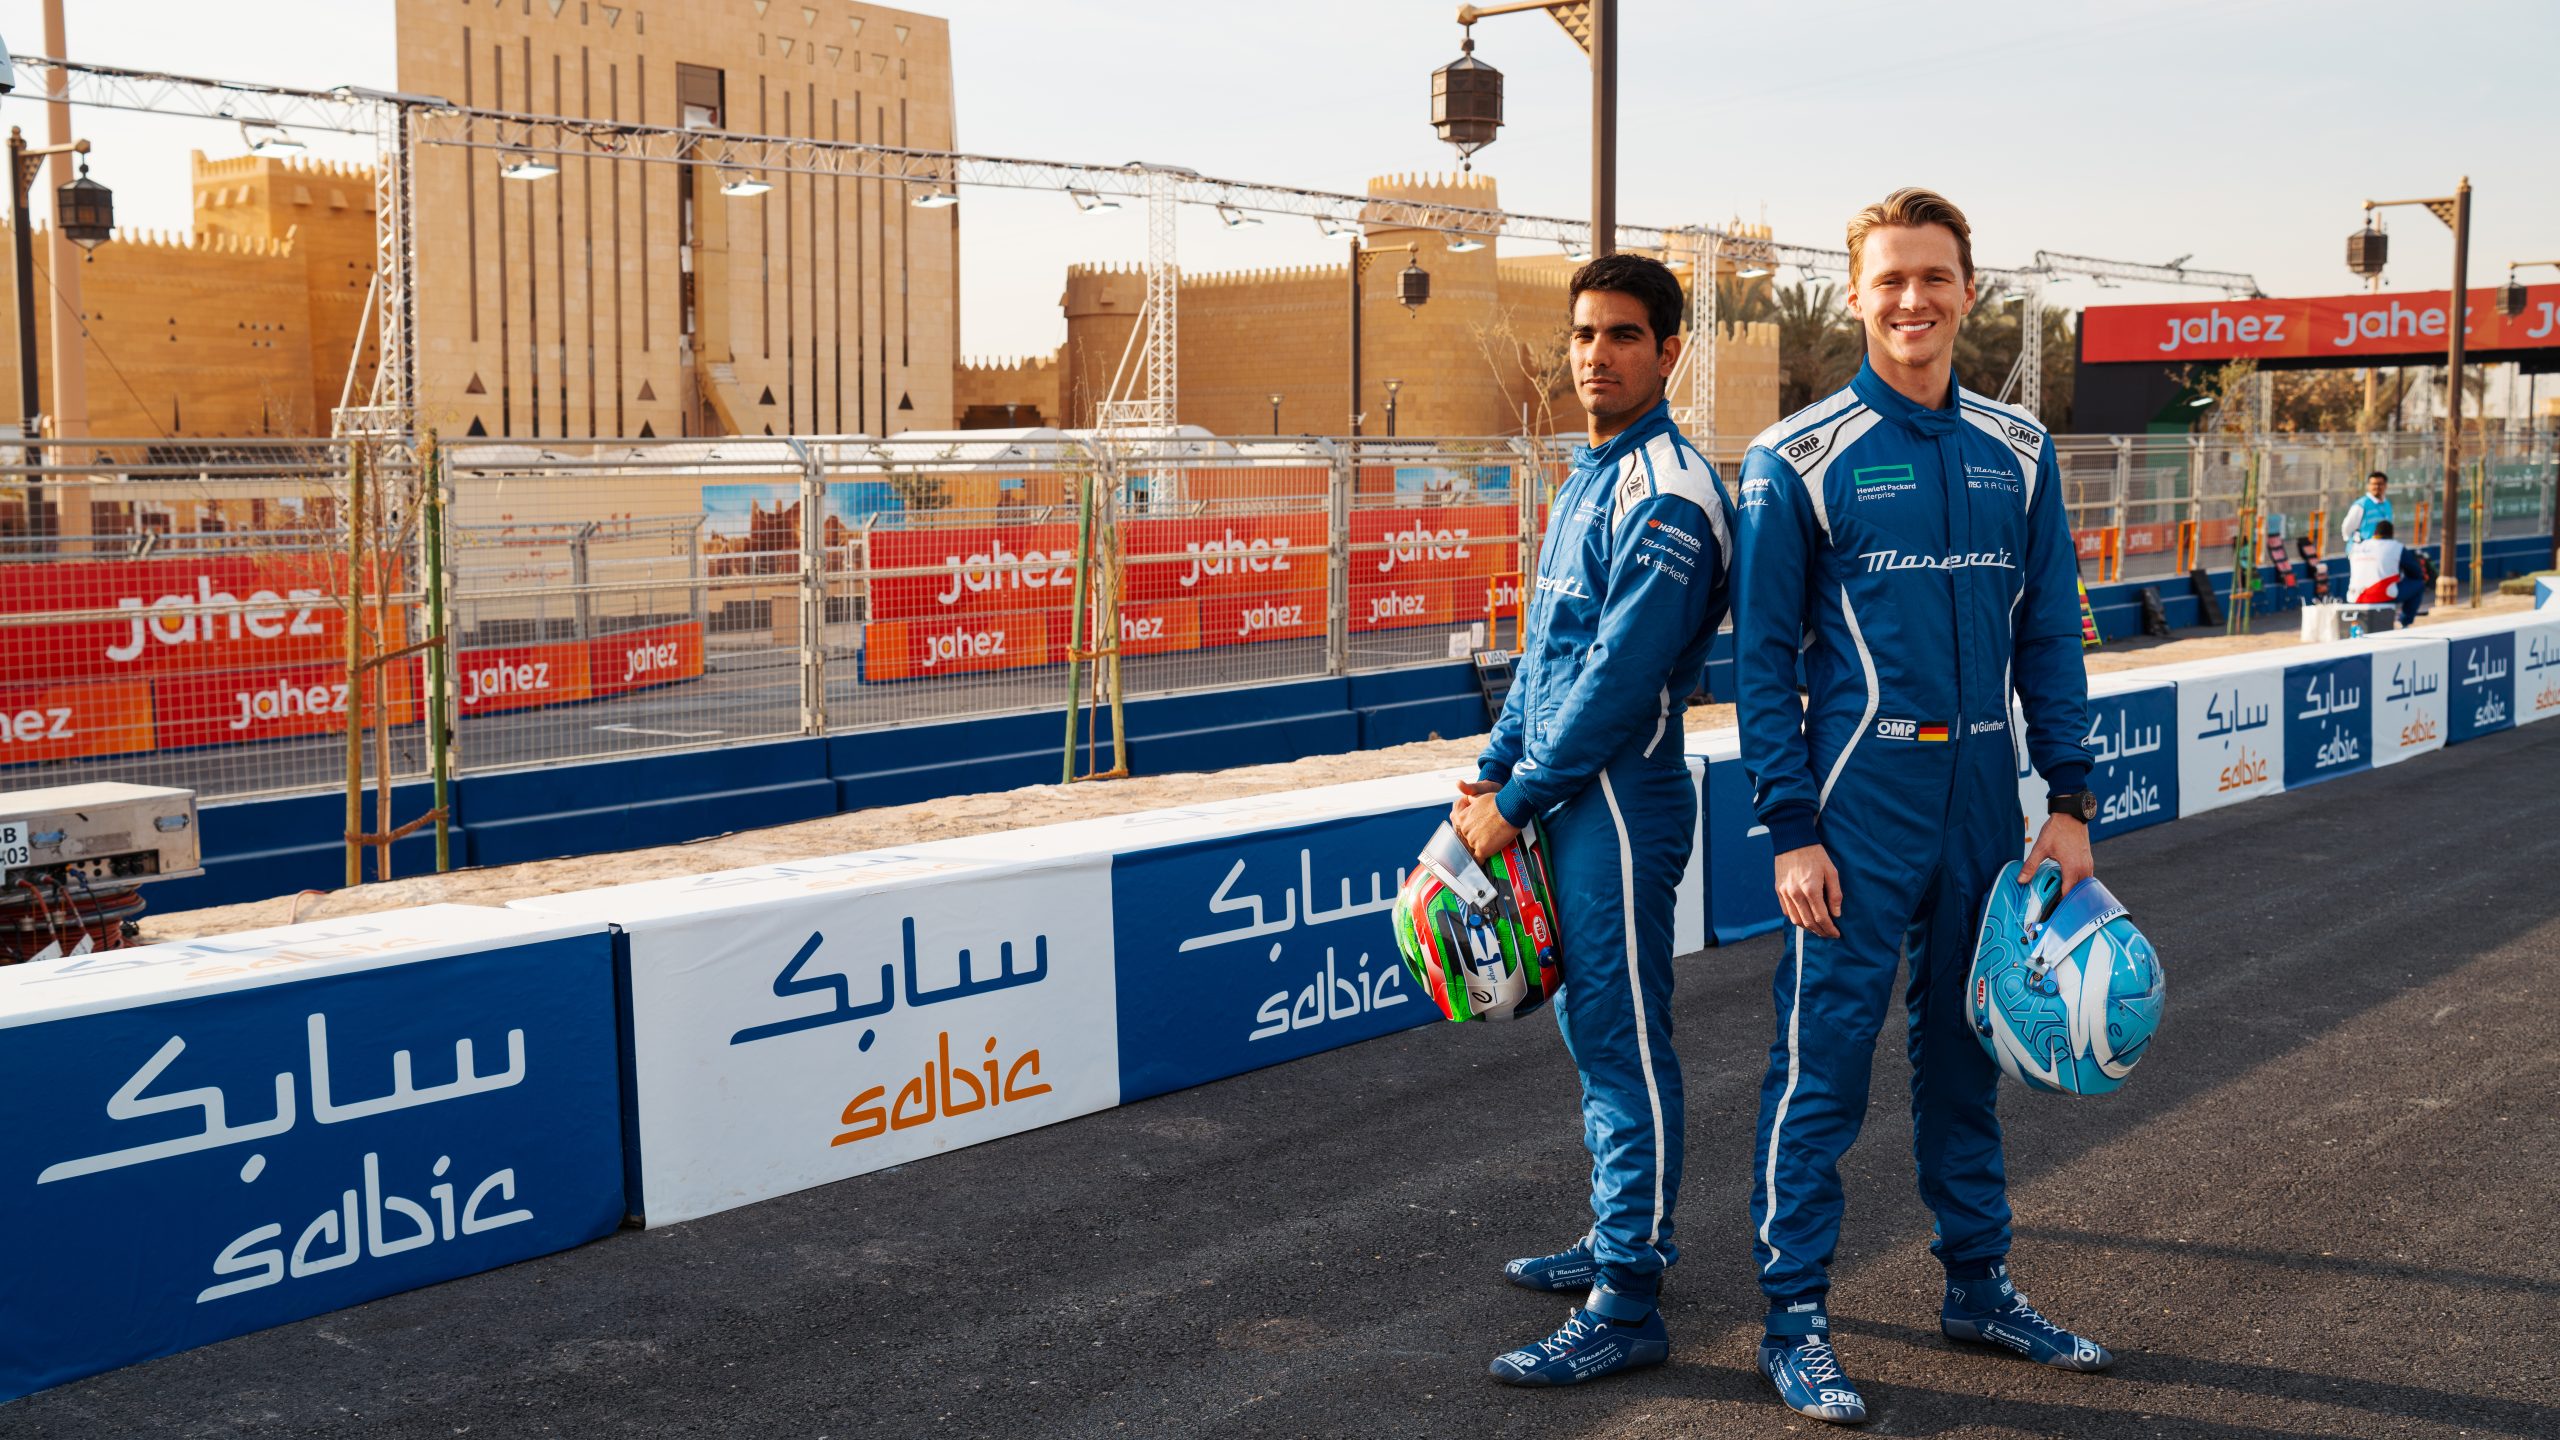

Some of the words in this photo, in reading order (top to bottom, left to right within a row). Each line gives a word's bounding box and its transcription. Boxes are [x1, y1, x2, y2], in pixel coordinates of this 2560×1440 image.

[1789, 436, 1820, 458] OMP
[2008, 426, 2040, 445] OMP
[1857, 485, 1887, 494] Hewlett
[1888, 483, 1916, 491] Packard
[1858, 492, 1895, 501] Enterprise
[1984, 482, 2018, 492] RACING
[1641, 537, 1695, 568] Maserati
[1858, 548, 2016, 574] Maserati
[1652, 559, 1689, 585] markets
[2462, 645, 2507, 695] سابك
[2386, 660, 2438, 711] سابك
[2298, 673, 2360, 730] سابك
[1877, 721, 1916, 737] OMP
[1979, 720, 2005, 733] Günther
[2198, 689, 2268, 750] سابك
[1534, 918, 1545, 940] BELL
[730, 916, 1048, 1053] سابك
[1249, 946, 1408, 1042] sabic
[1977, 979, 1985, 1006] BELL
[36, 1013, 526, 1184] سابك
[831, 1031, 1053, 1148] sabic
[195, 1152, 535, 1305] sabic
[1591, 1352, 1623, 1374] RACING
